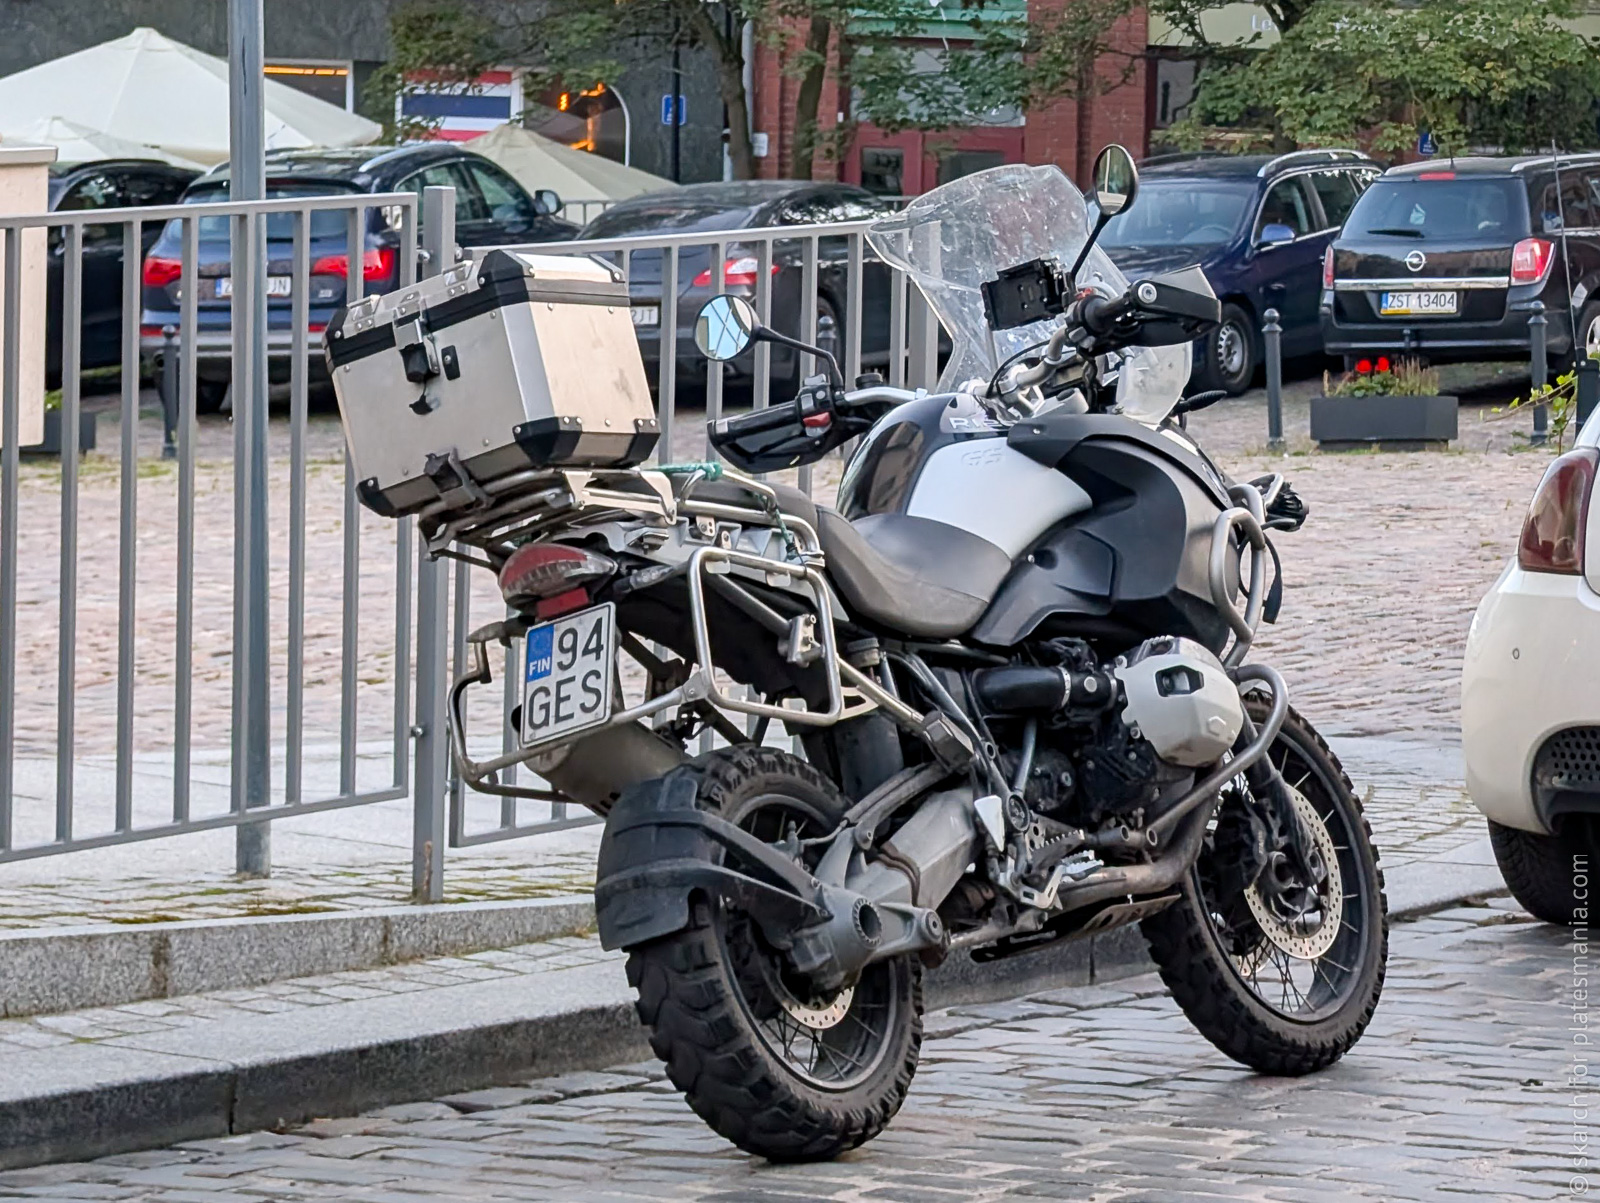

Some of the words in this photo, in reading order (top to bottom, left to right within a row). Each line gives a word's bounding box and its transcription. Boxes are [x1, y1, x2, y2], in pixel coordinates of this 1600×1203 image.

[1389, 294, 1411, 309] ZST
[1417, 293, 1455, 309] 13404
[556, 617, 604, 671] 94
[529, 656, 551, 676] FIN
[527, 669, 602, 731] GES
